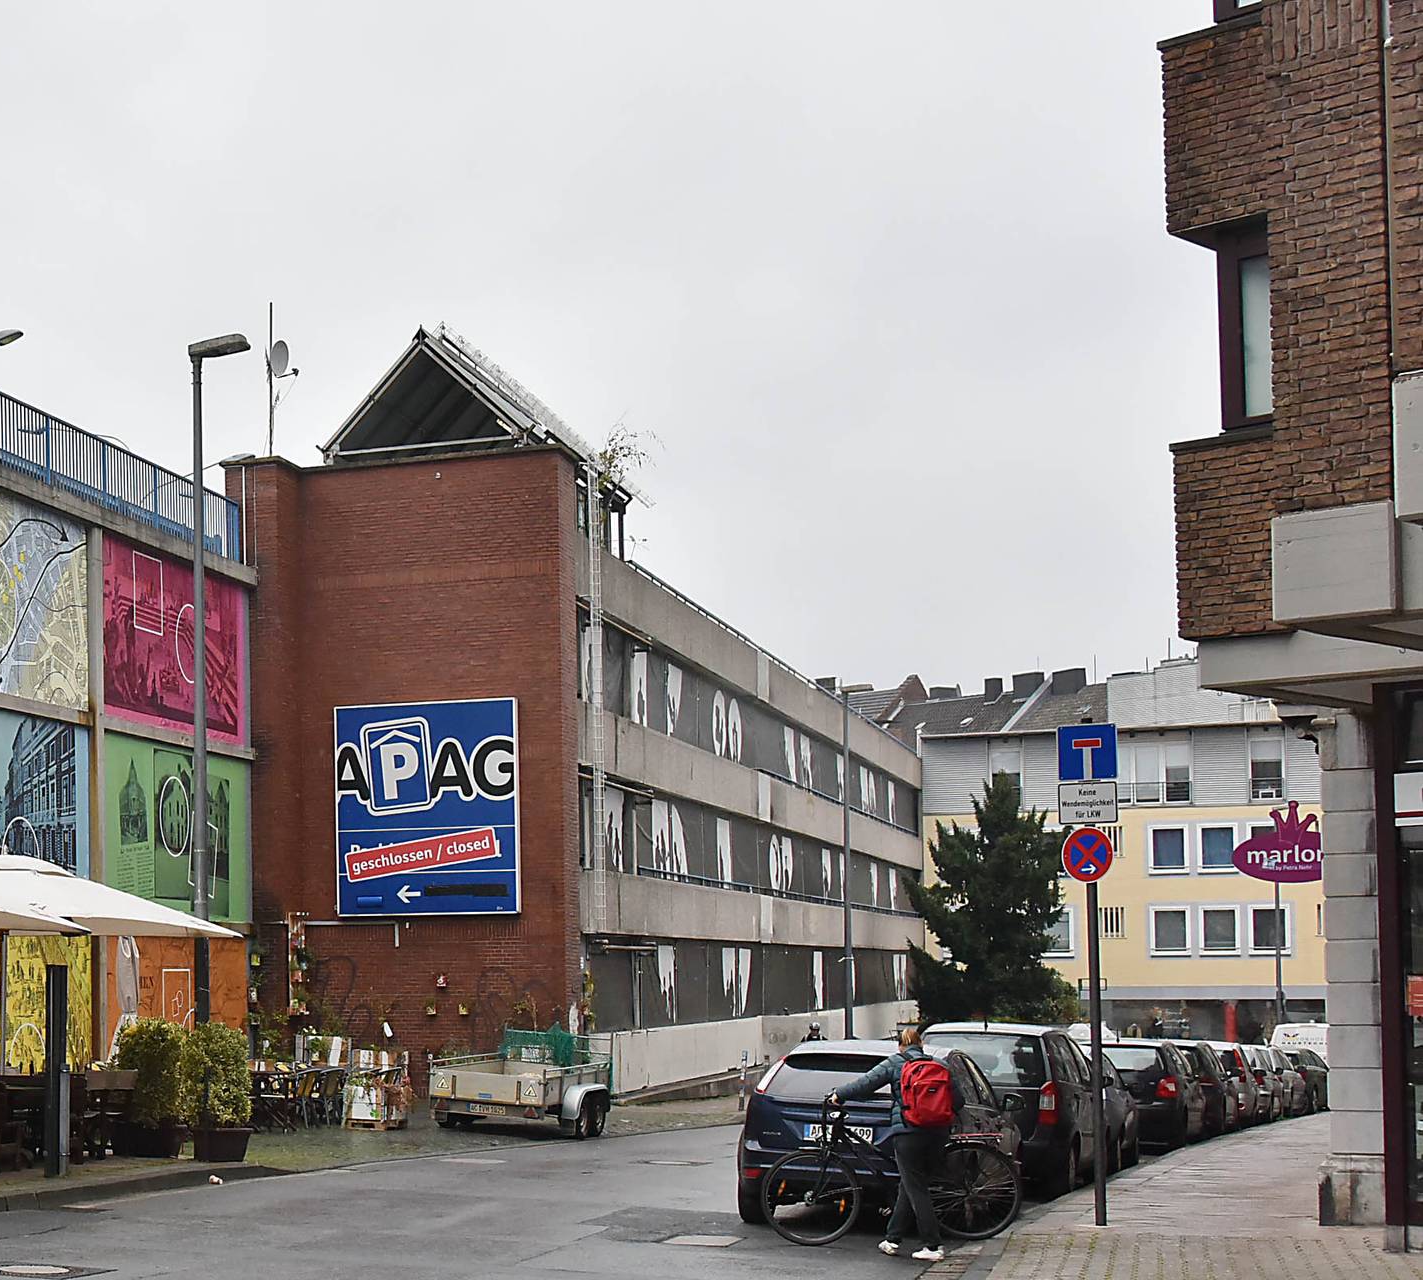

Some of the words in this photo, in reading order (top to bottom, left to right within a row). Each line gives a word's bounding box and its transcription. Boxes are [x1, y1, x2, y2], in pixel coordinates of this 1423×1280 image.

[338, 739, 514, 801] APAG
[1078, 788, 1097, 797] Keine
[1061, 800, 1115, 809] Wendemöglichkeit
[1075, 811, 1085, 819] für
[1086, 810, 1101, 819] LKW
[352, 848, 433, 875] geschlossen
[446, 836, 491, 856] closed
